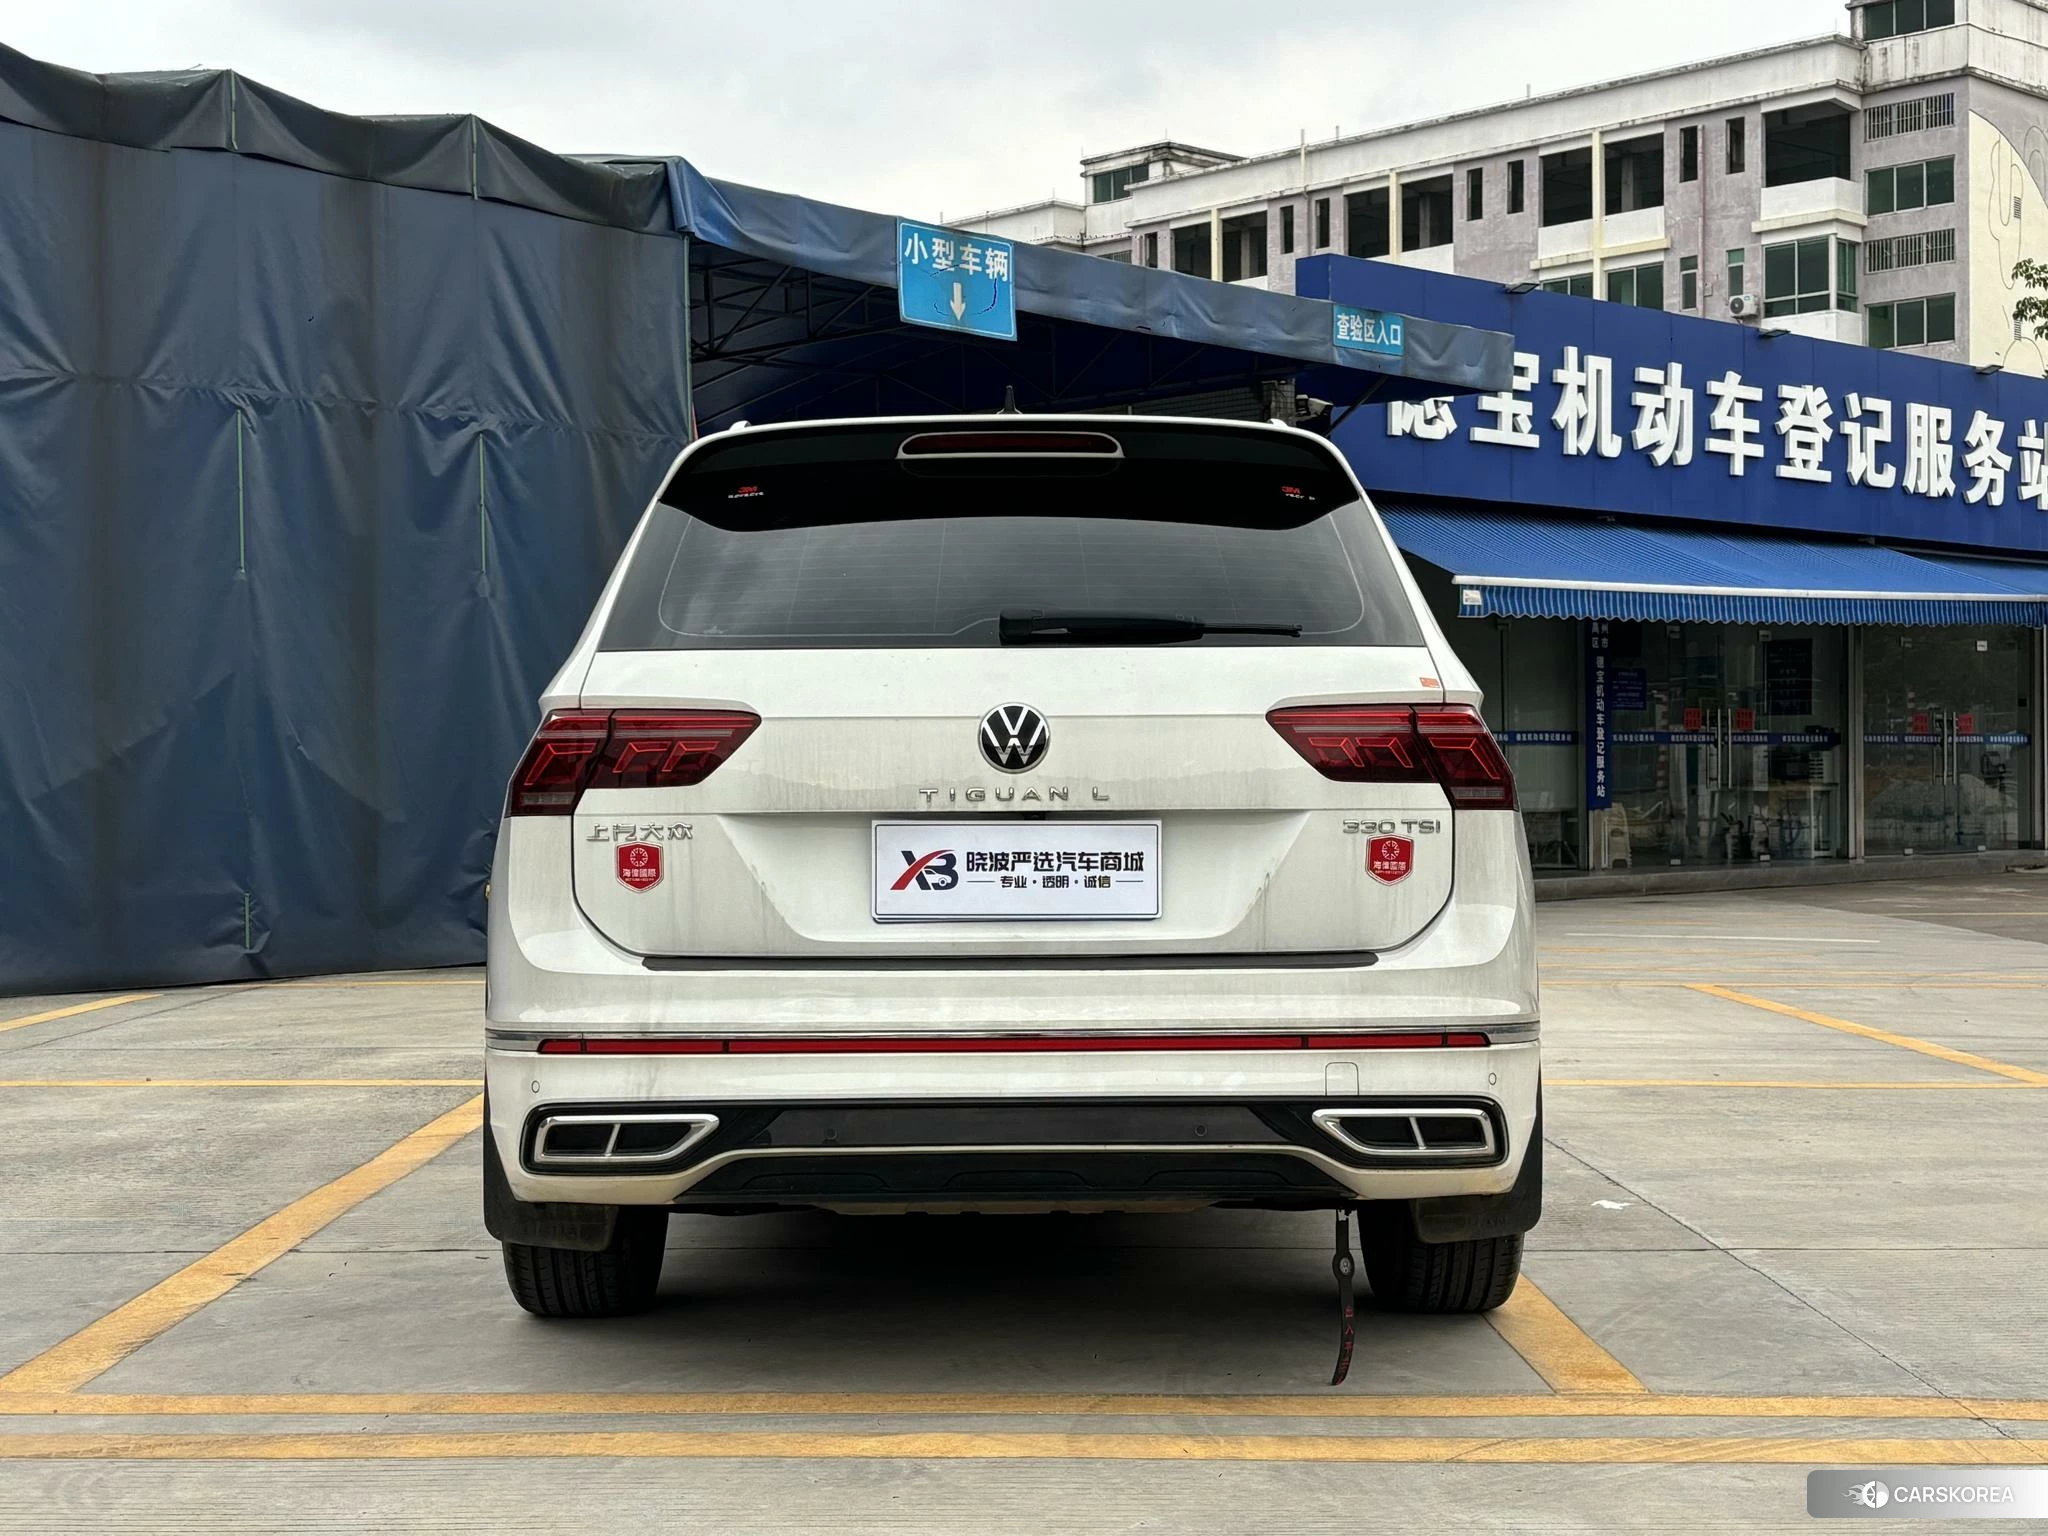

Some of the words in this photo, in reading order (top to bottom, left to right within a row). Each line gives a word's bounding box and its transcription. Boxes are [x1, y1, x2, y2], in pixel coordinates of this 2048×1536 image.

[904, 232, 1009, 282] 小型车辆
[1336, 313, 1401, 346] 查验区入口
[919, 786, 1068, 803] TIGUAN
[1091, 786, 1110, 802] L
[586, 822, 693, 841] 上汽大众
[1343, 819, 1396, 834] 330
[1401, 819, 1441, 834] TSI
[966, 851, 1145, 872] 晓波严选汽车商城
